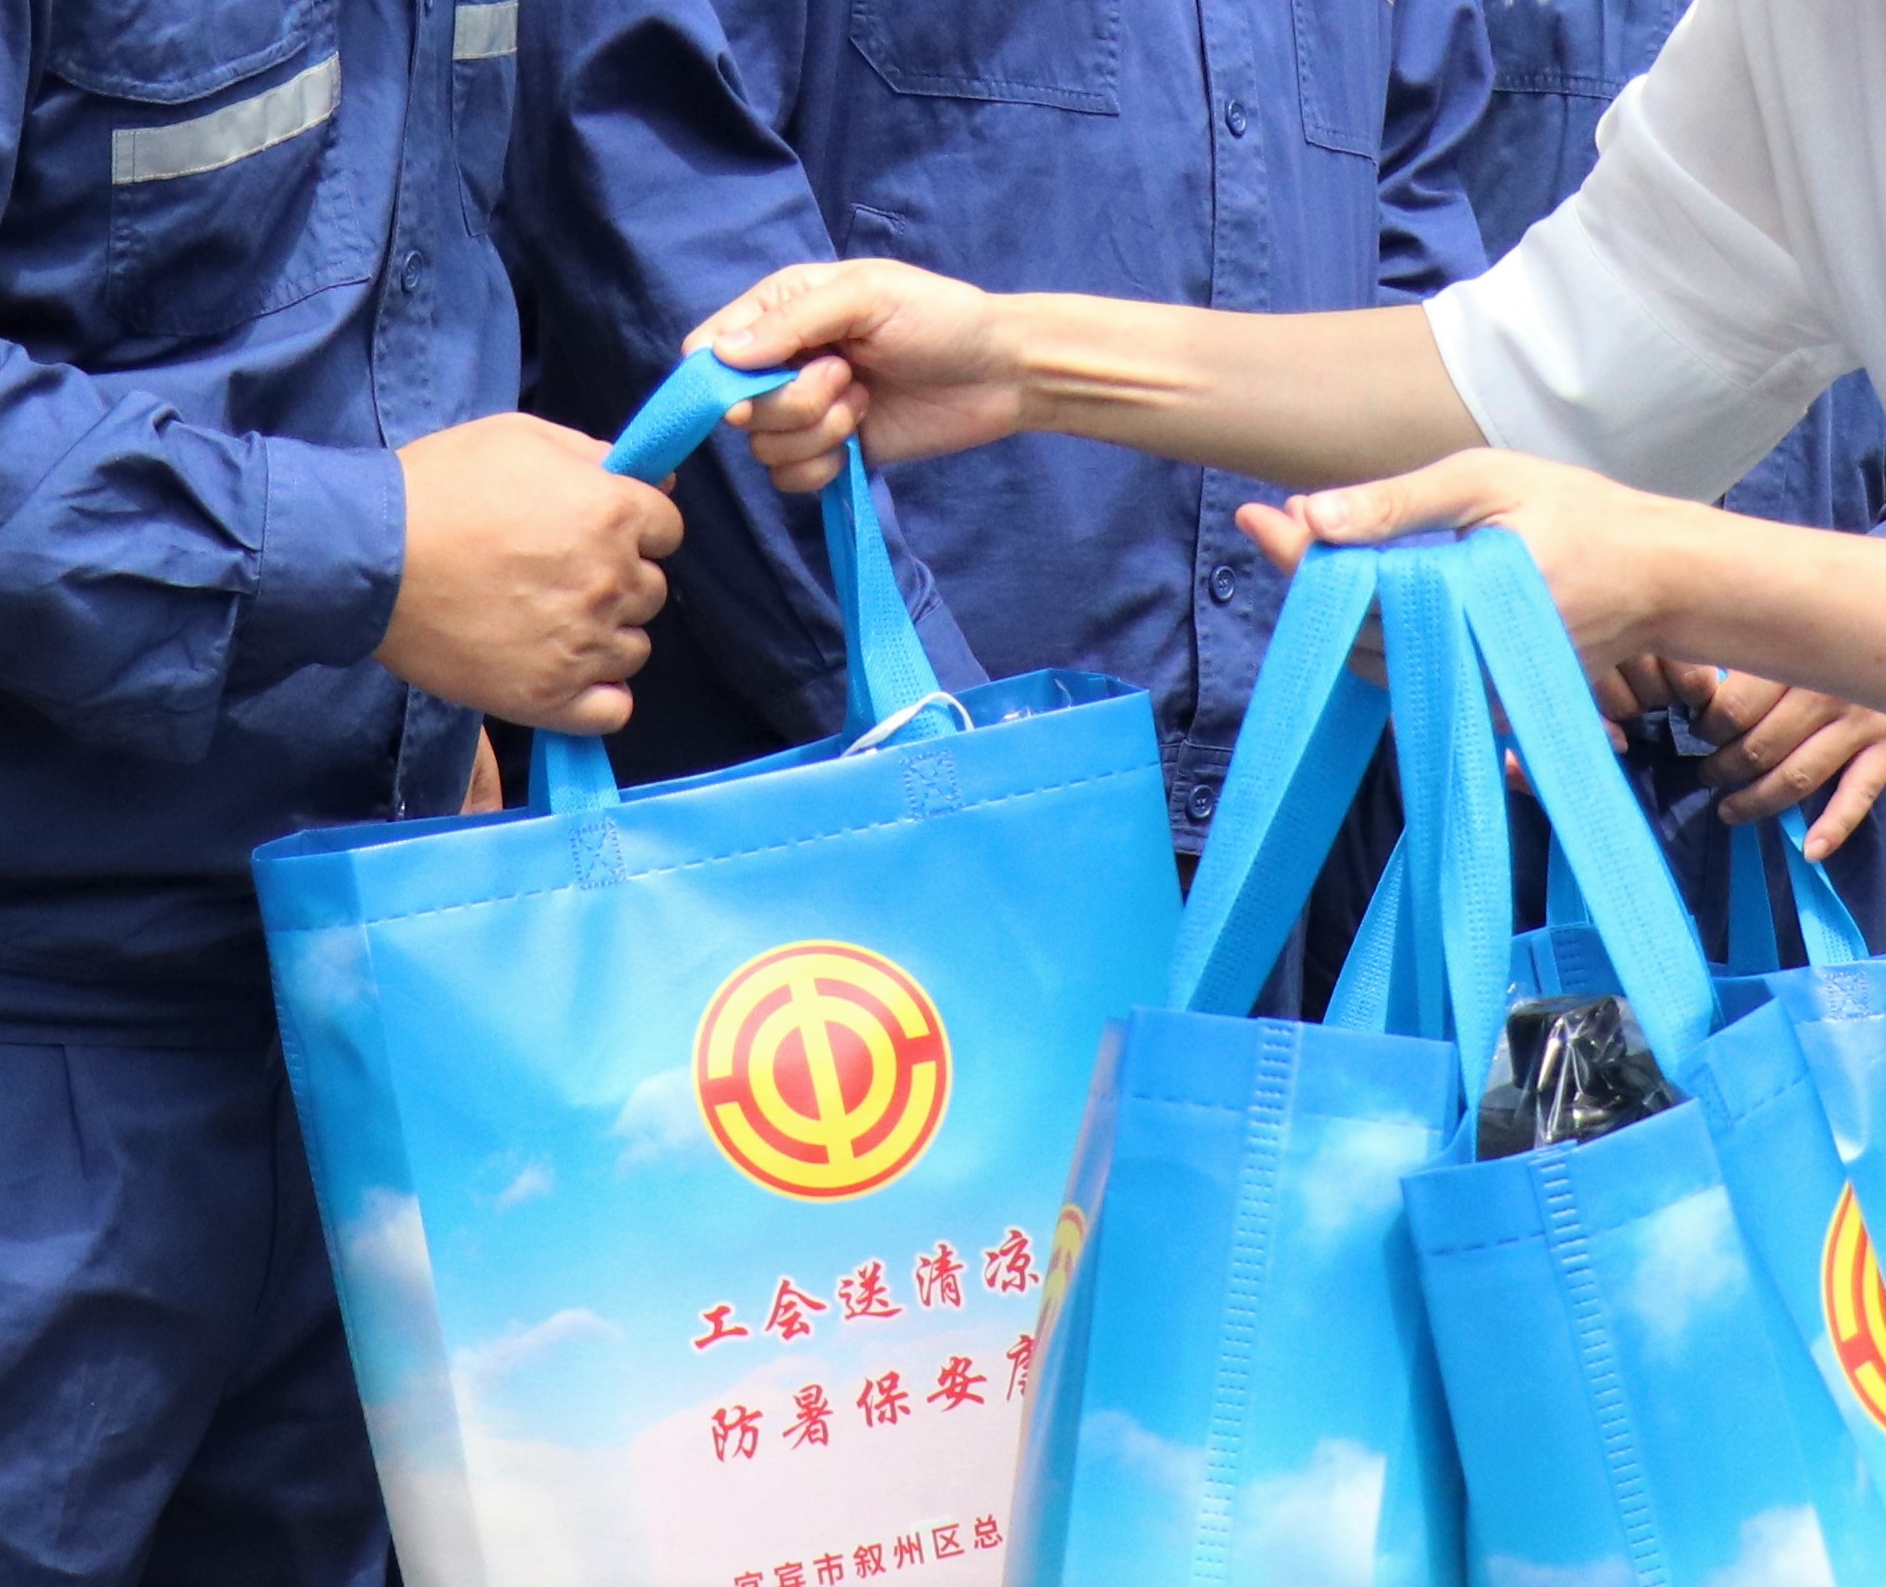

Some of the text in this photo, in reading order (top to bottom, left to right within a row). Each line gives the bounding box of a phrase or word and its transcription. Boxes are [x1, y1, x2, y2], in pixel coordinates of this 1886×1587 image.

[694, 1228, 1040, 1350] 工会送清凉
